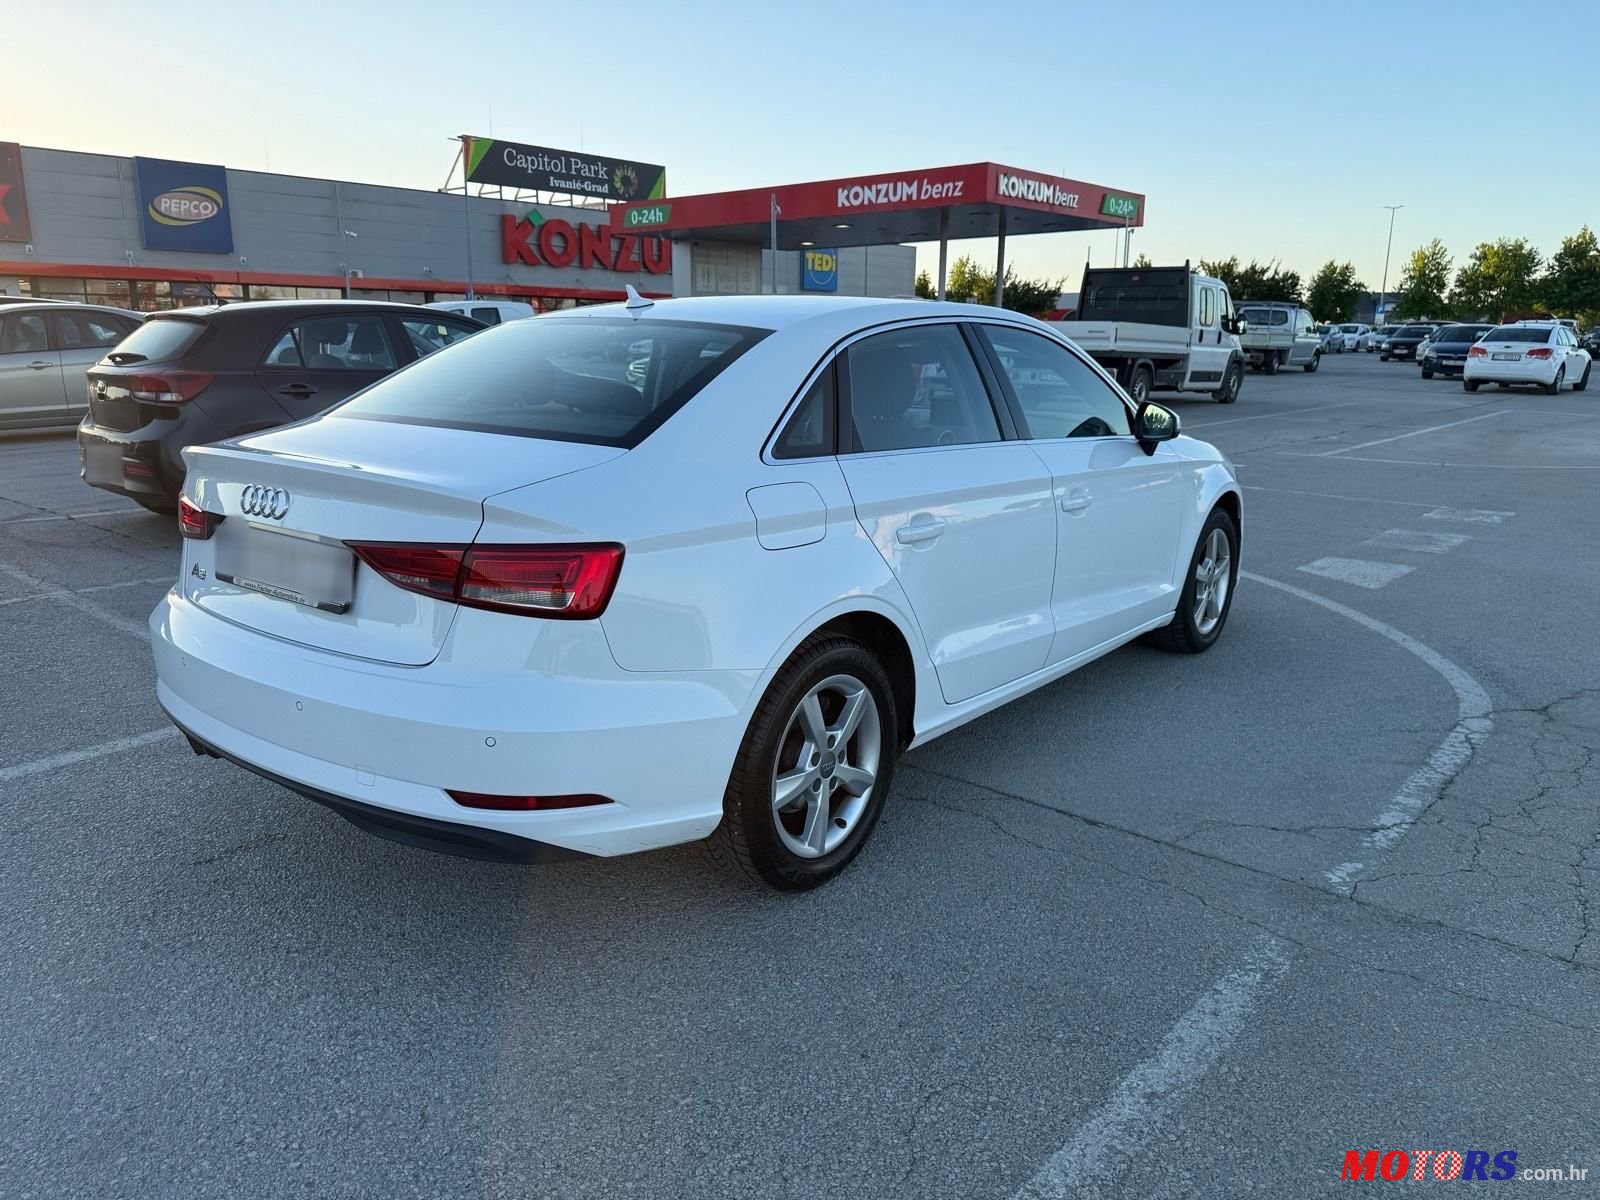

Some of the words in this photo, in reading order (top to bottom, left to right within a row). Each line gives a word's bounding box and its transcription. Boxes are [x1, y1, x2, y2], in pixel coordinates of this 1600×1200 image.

[503, 148, 567, 174] Capitol
[569, 158, 609, 179] Park
[549, 176, 609, 194] Ivanić-Grad
[837, 180, 918, 208] KONZUM
[921, 178, 964, 200] benz
[998, 174, 1054, 204] KONZUM
[1054, 184, 1080, 208] benz
[160, 198, 213, 214] PEPCO
[631, 207, 663, 225] 0-24h
[805, 252, 836, 273] TEDi
